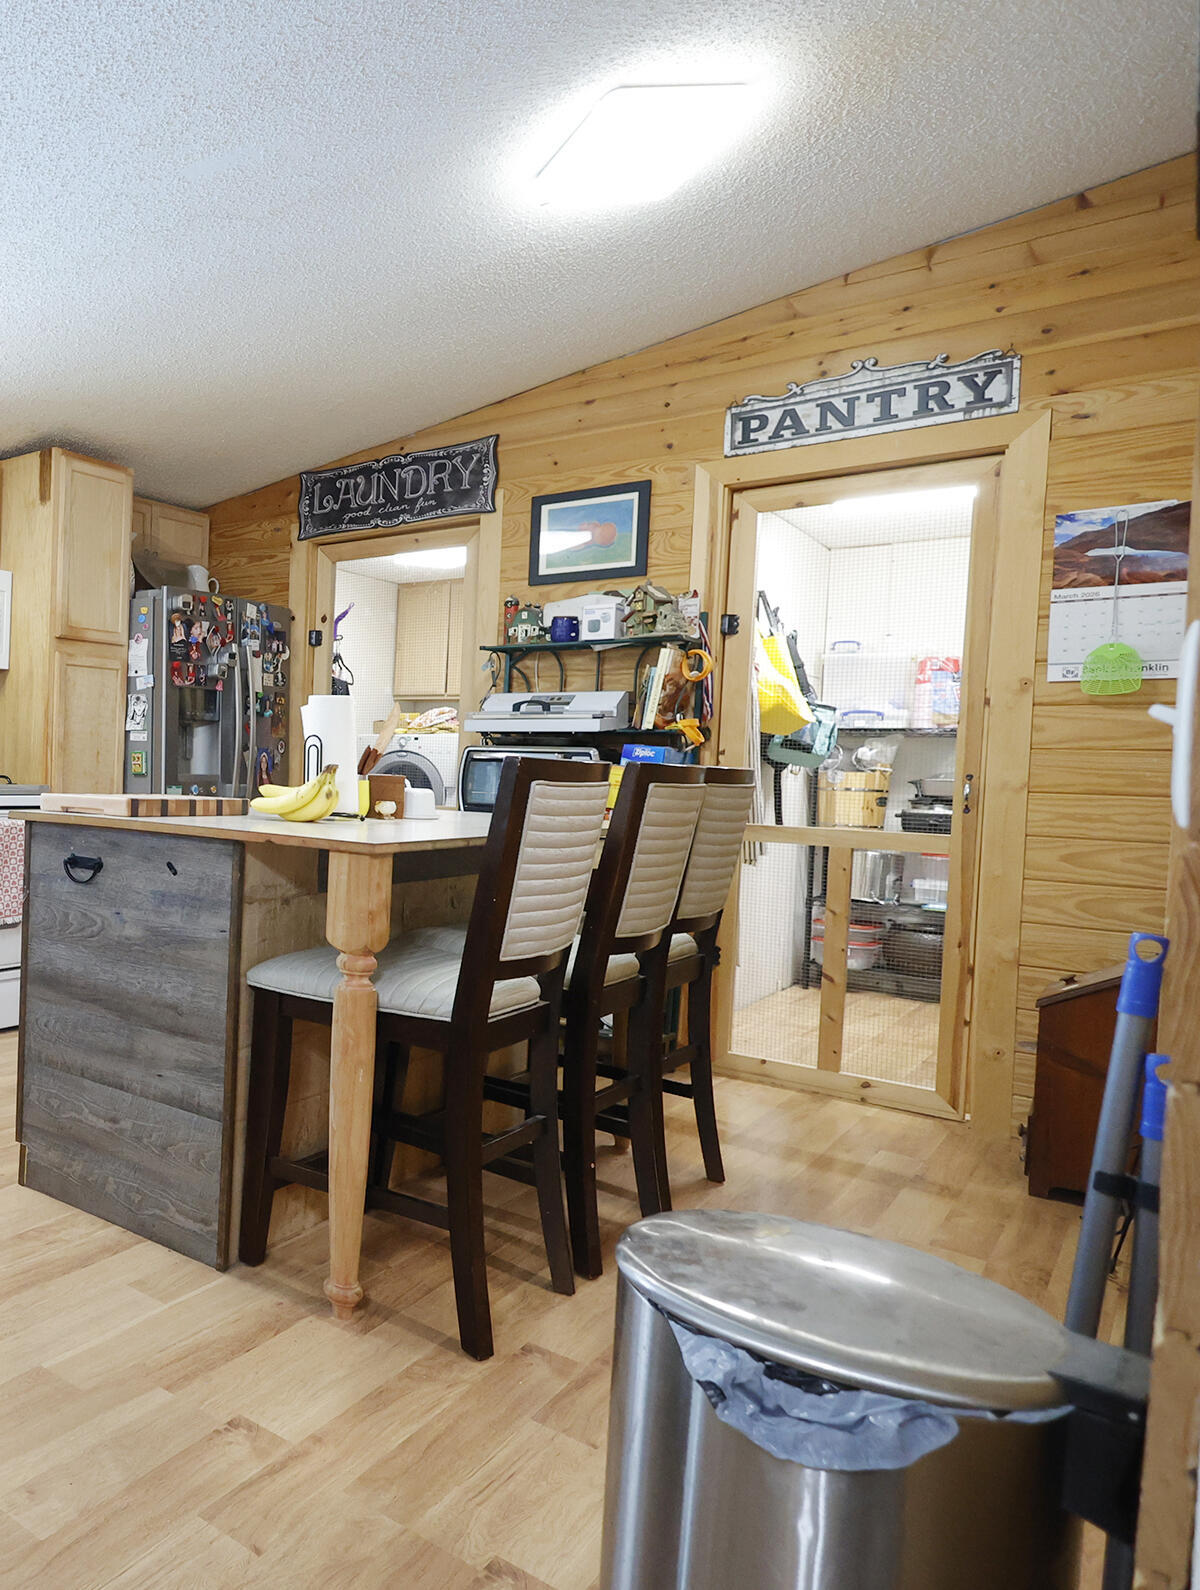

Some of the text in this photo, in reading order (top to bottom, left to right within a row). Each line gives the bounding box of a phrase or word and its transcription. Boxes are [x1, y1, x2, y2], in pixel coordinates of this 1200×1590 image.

[736, 368, 1003, 445] PANTRY
[312, 453, 481, 515] LAUNDRY
[342, 497, 437, 523] good clean fun
[1053, 593, 1079, 601] March
